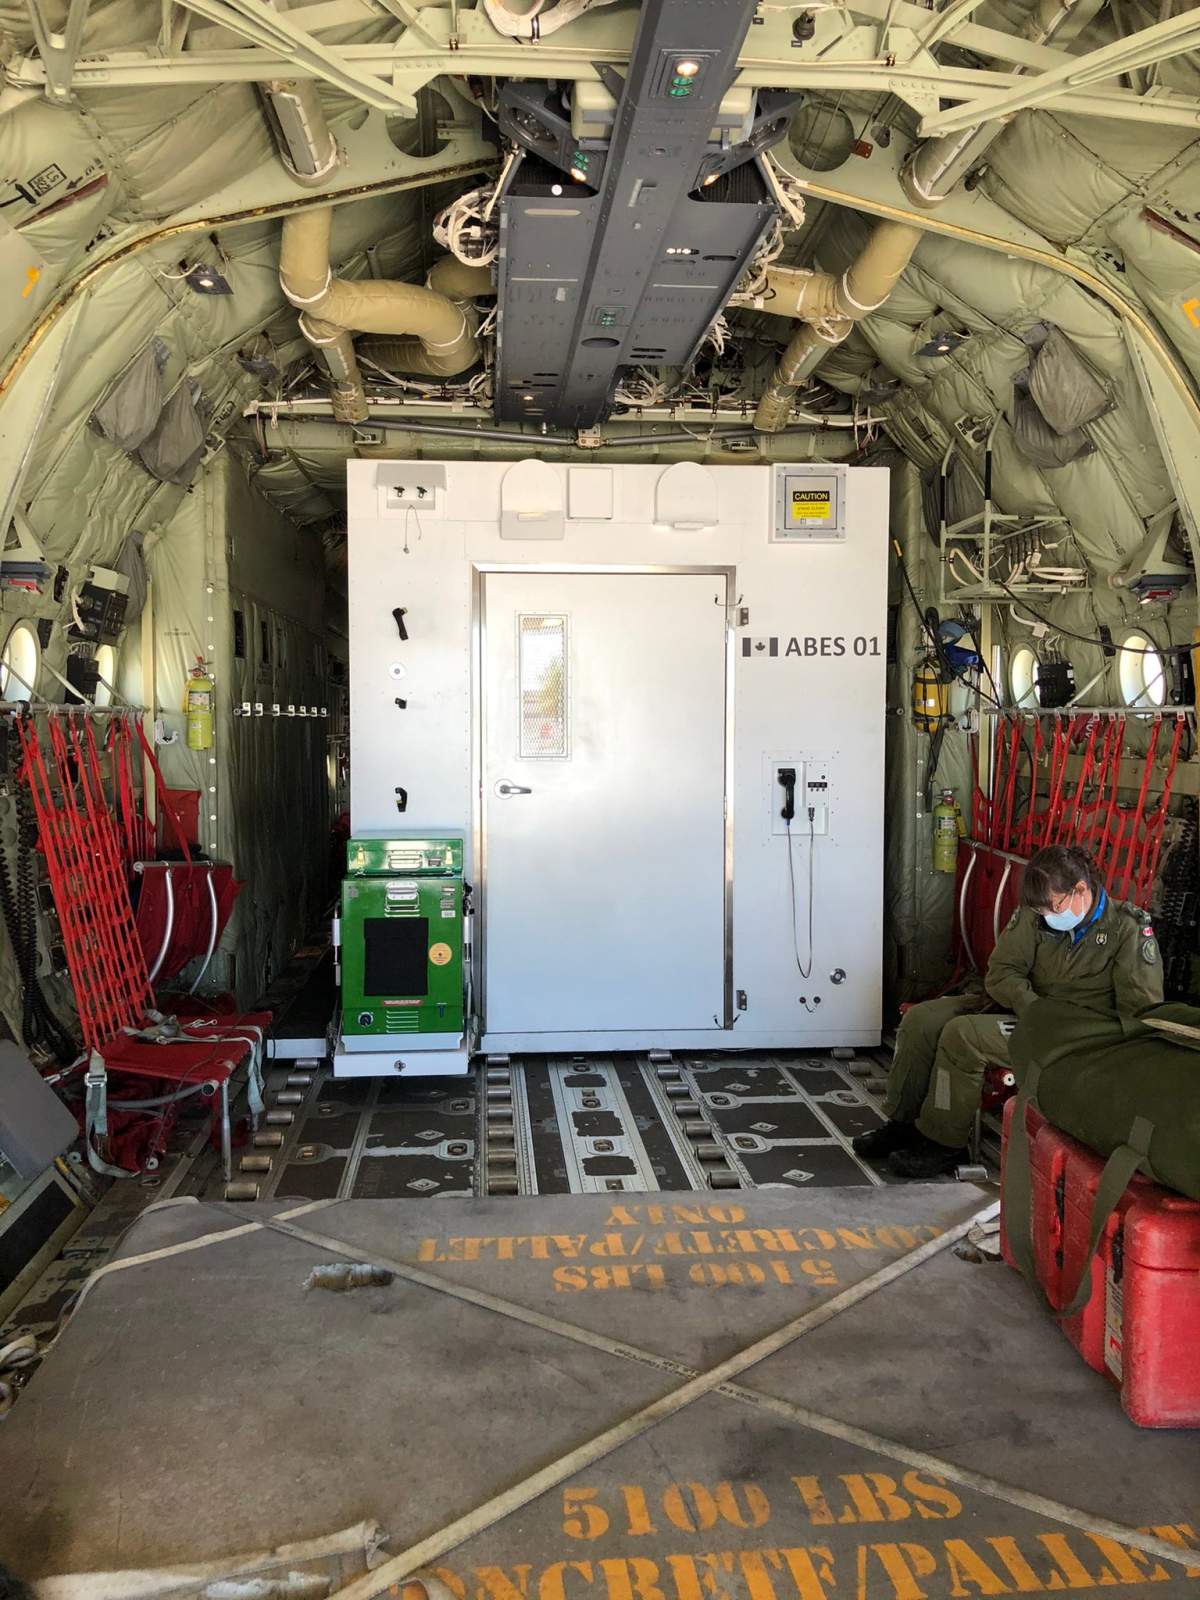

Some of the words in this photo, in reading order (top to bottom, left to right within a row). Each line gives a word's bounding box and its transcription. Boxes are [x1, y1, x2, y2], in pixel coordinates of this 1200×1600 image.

[794, 492, 828, 501] CAUTION
[785, 637, 846, 657] ABES
[853, 636, 881, 657] 01
[604, 1204, 748, 1226] ONLY
[552, 1263, 665, 1293] LBS
[689, 1258, 839, 1288] 5100
[562, 1479, 771, 1540] 5100
[791, 1470, 963, 1525] LBS
